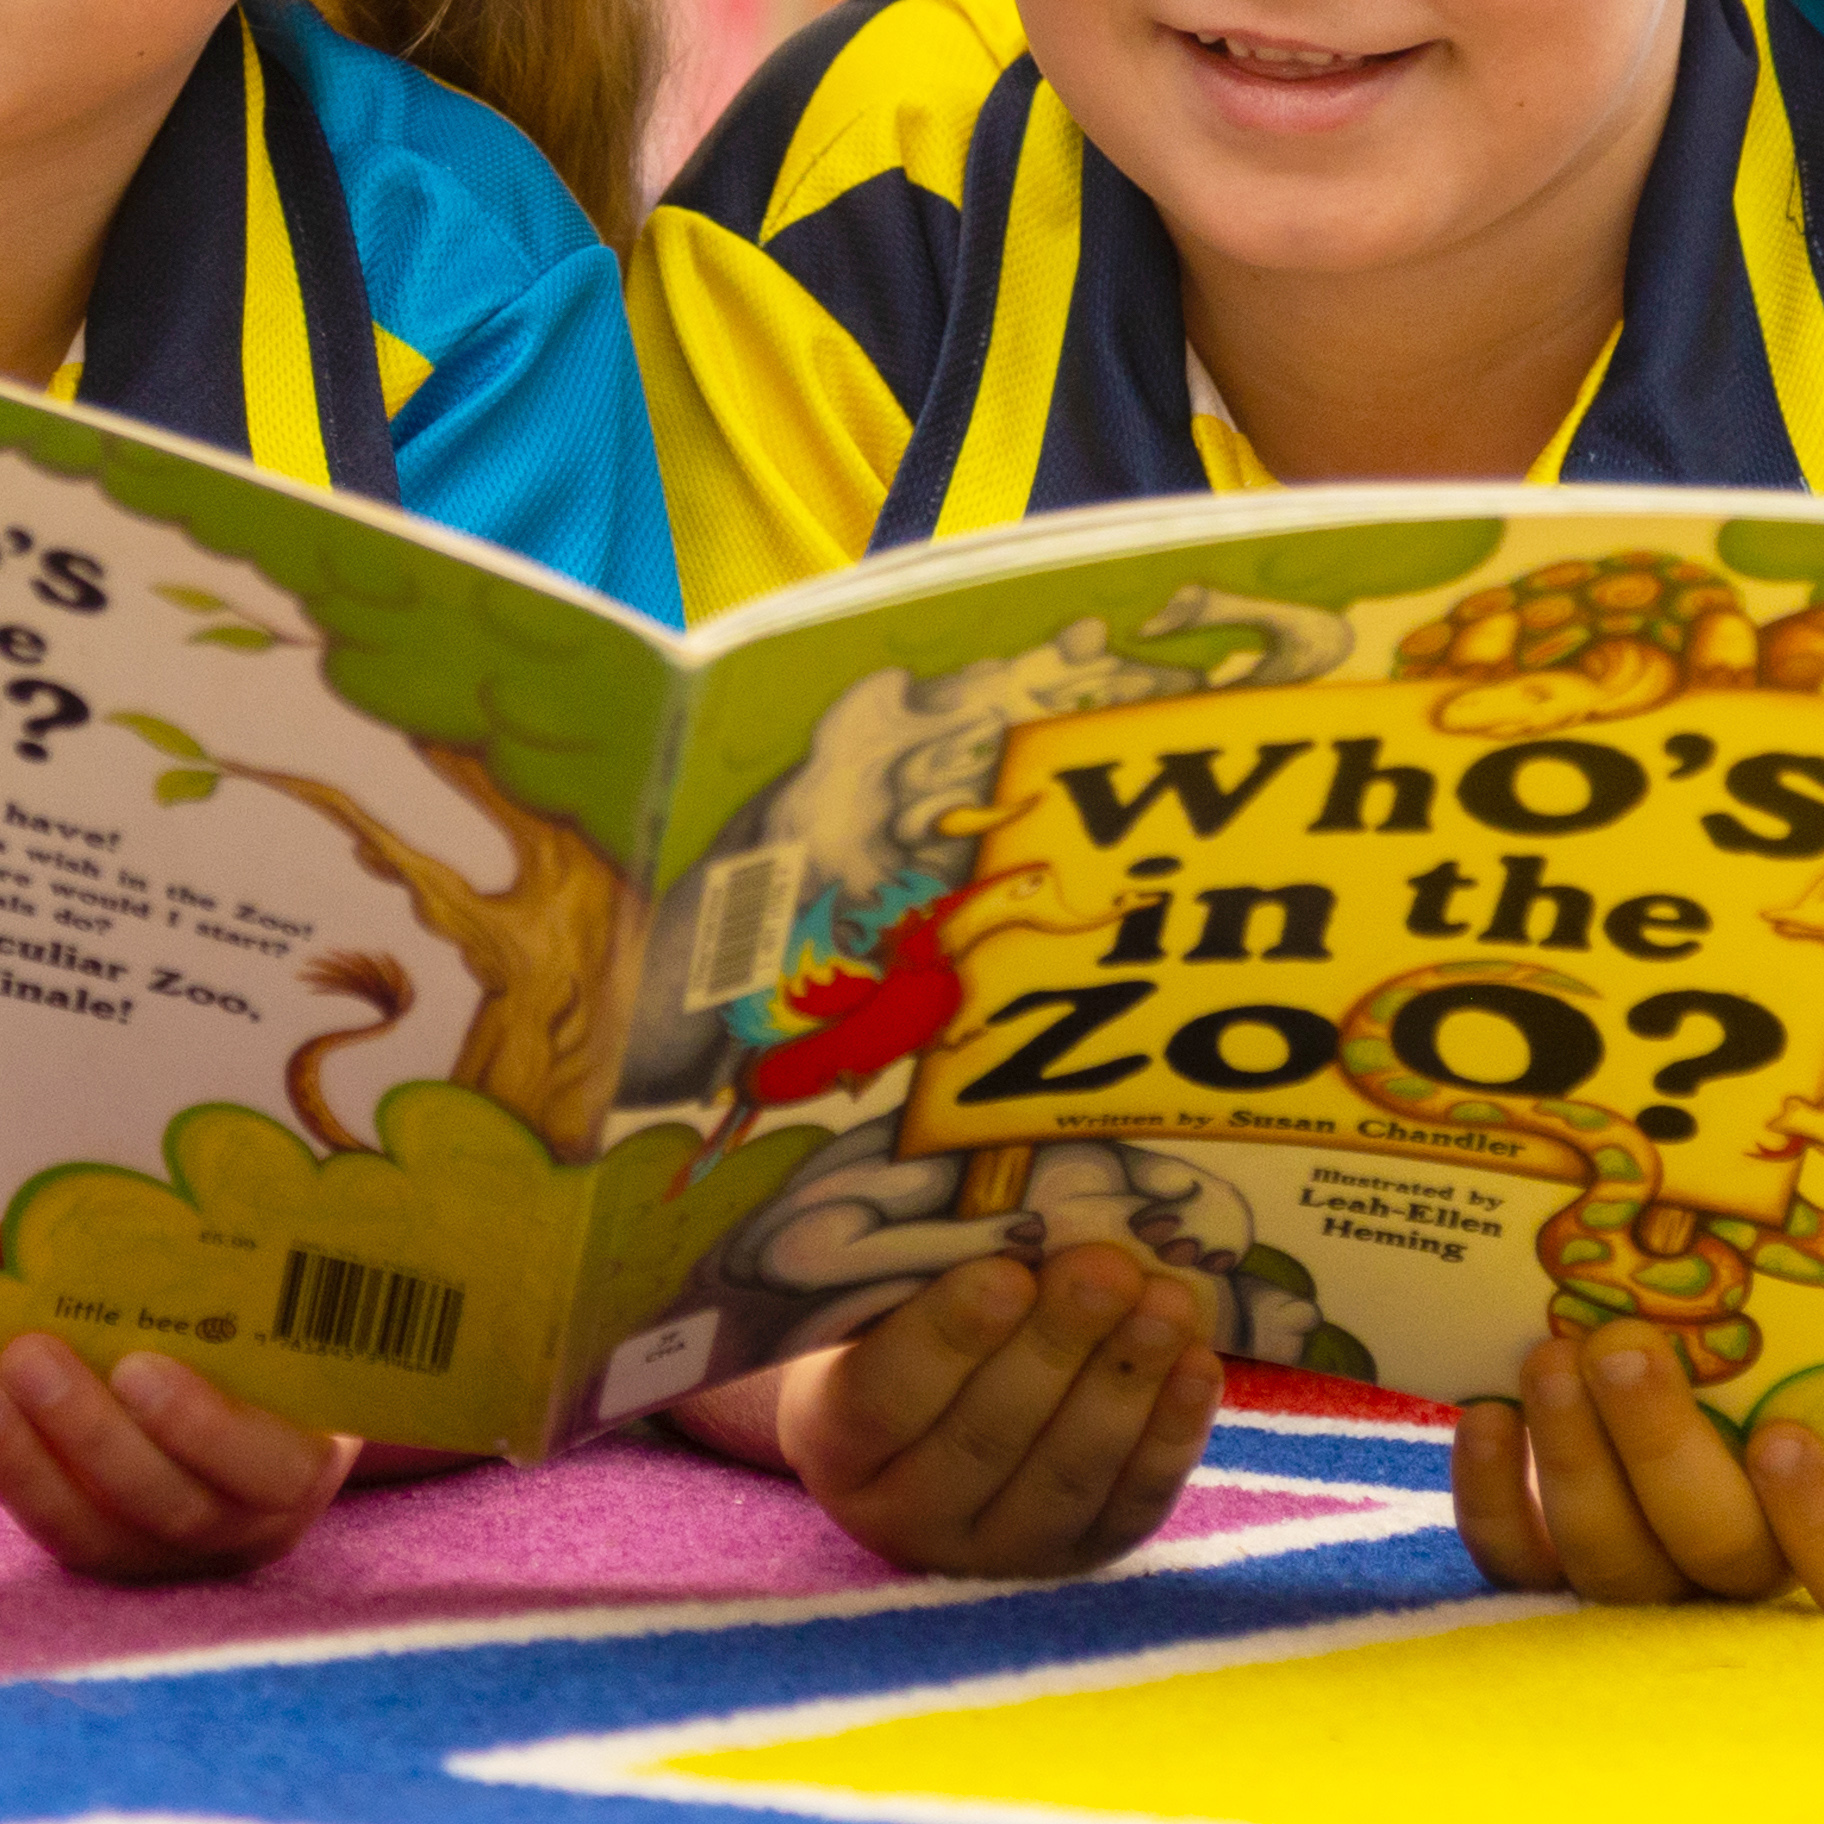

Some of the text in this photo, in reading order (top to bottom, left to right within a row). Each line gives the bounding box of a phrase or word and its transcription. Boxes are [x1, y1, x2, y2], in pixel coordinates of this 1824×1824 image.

[5, 801, 123, 853] have!
[25, 845, 101, 878] wish
[117, 868, 148, 893] in
[166, 882, 218, 912] the
[233, 900, 316, 940] Zoo!
[1098, 855, 1715, 966] in the
[49, 880, 152, 920] would
[194, 919, 292, 959] start?
[52, 907, 115, 937] do?
[1054, 1108, 1530, 1160] Written by Susan Chandler
[1298, 1186, 1504, 1240] Leah-Ellen
[1309, 1166, 1506, 1213] Illustrated by
[1321, 1216, 1469, 1264] Heming
[55, 1294, 190, 1336] little bee
